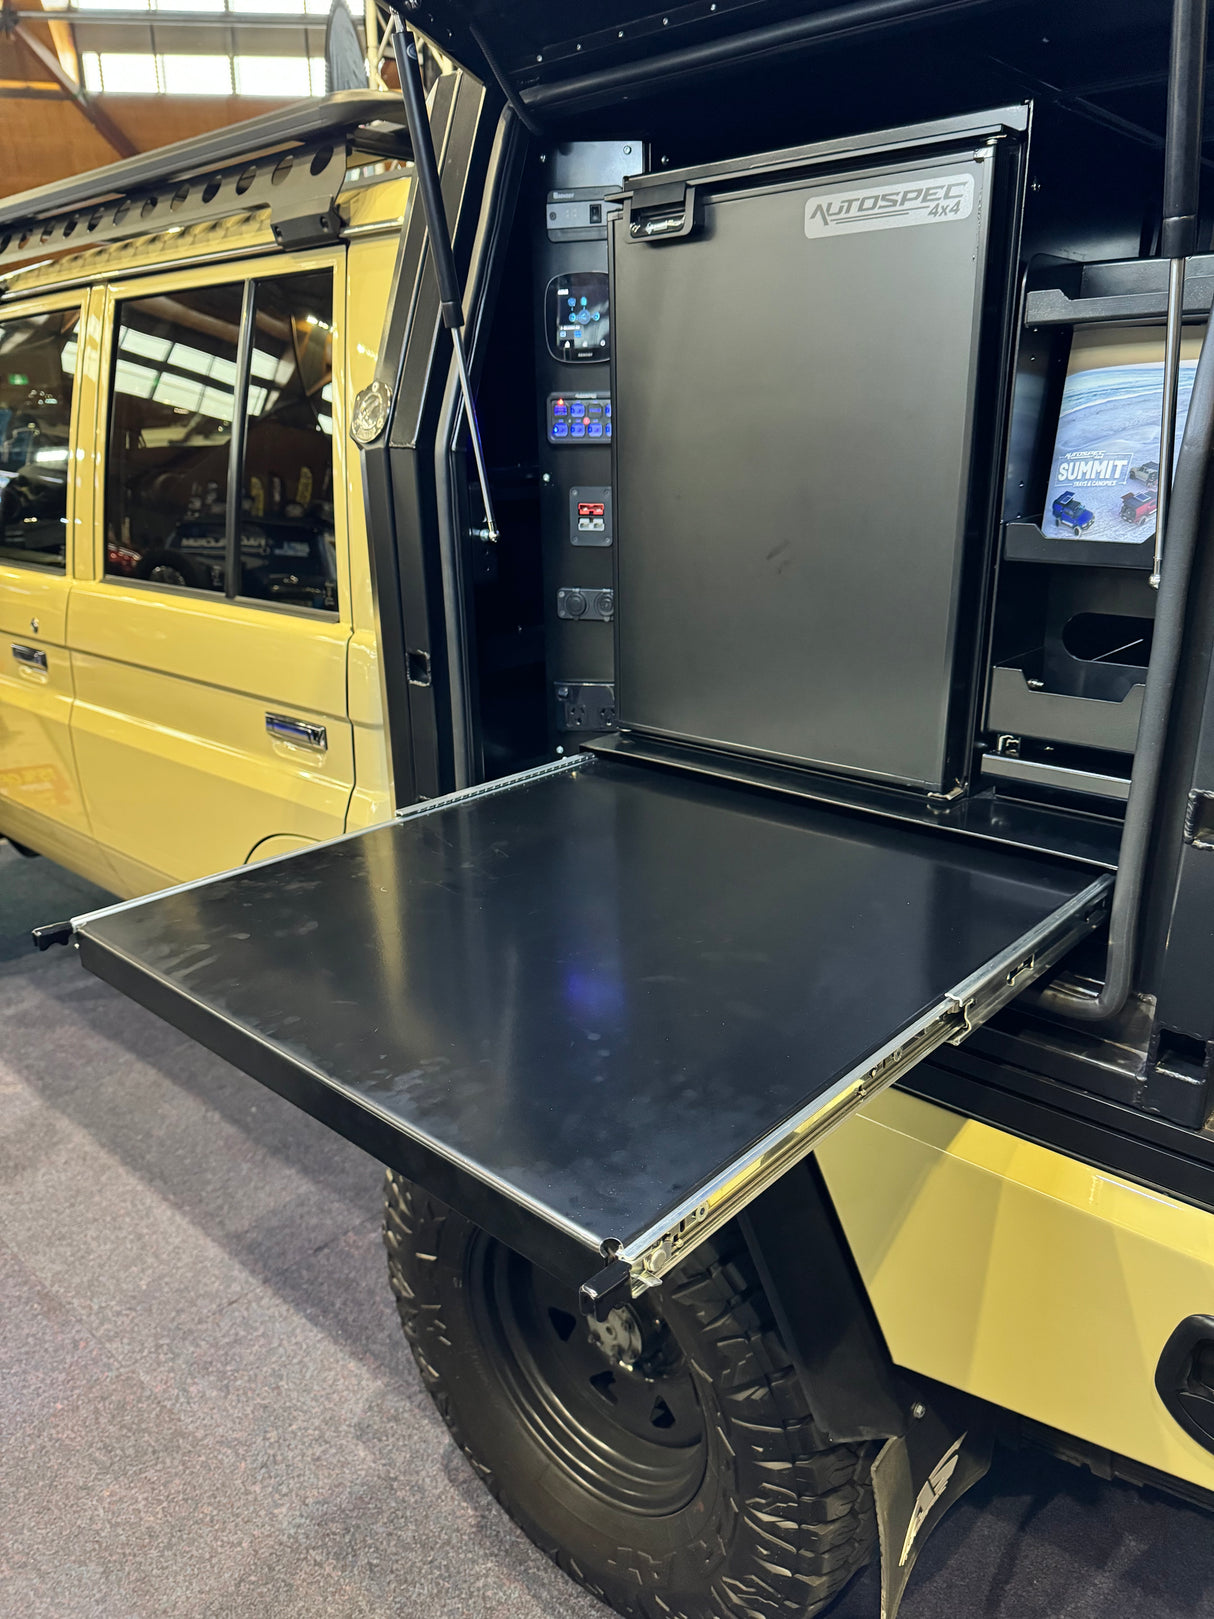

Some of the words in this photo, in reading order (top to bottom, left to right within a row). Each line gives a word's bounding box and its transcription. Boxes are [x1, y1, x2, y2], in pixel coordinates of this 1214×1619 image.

[809, 181, 969, 226] AUTOSPEC
[928, 199, 961, 218] 4x4
[1058, 460, 1128, 481] SUMMIT
